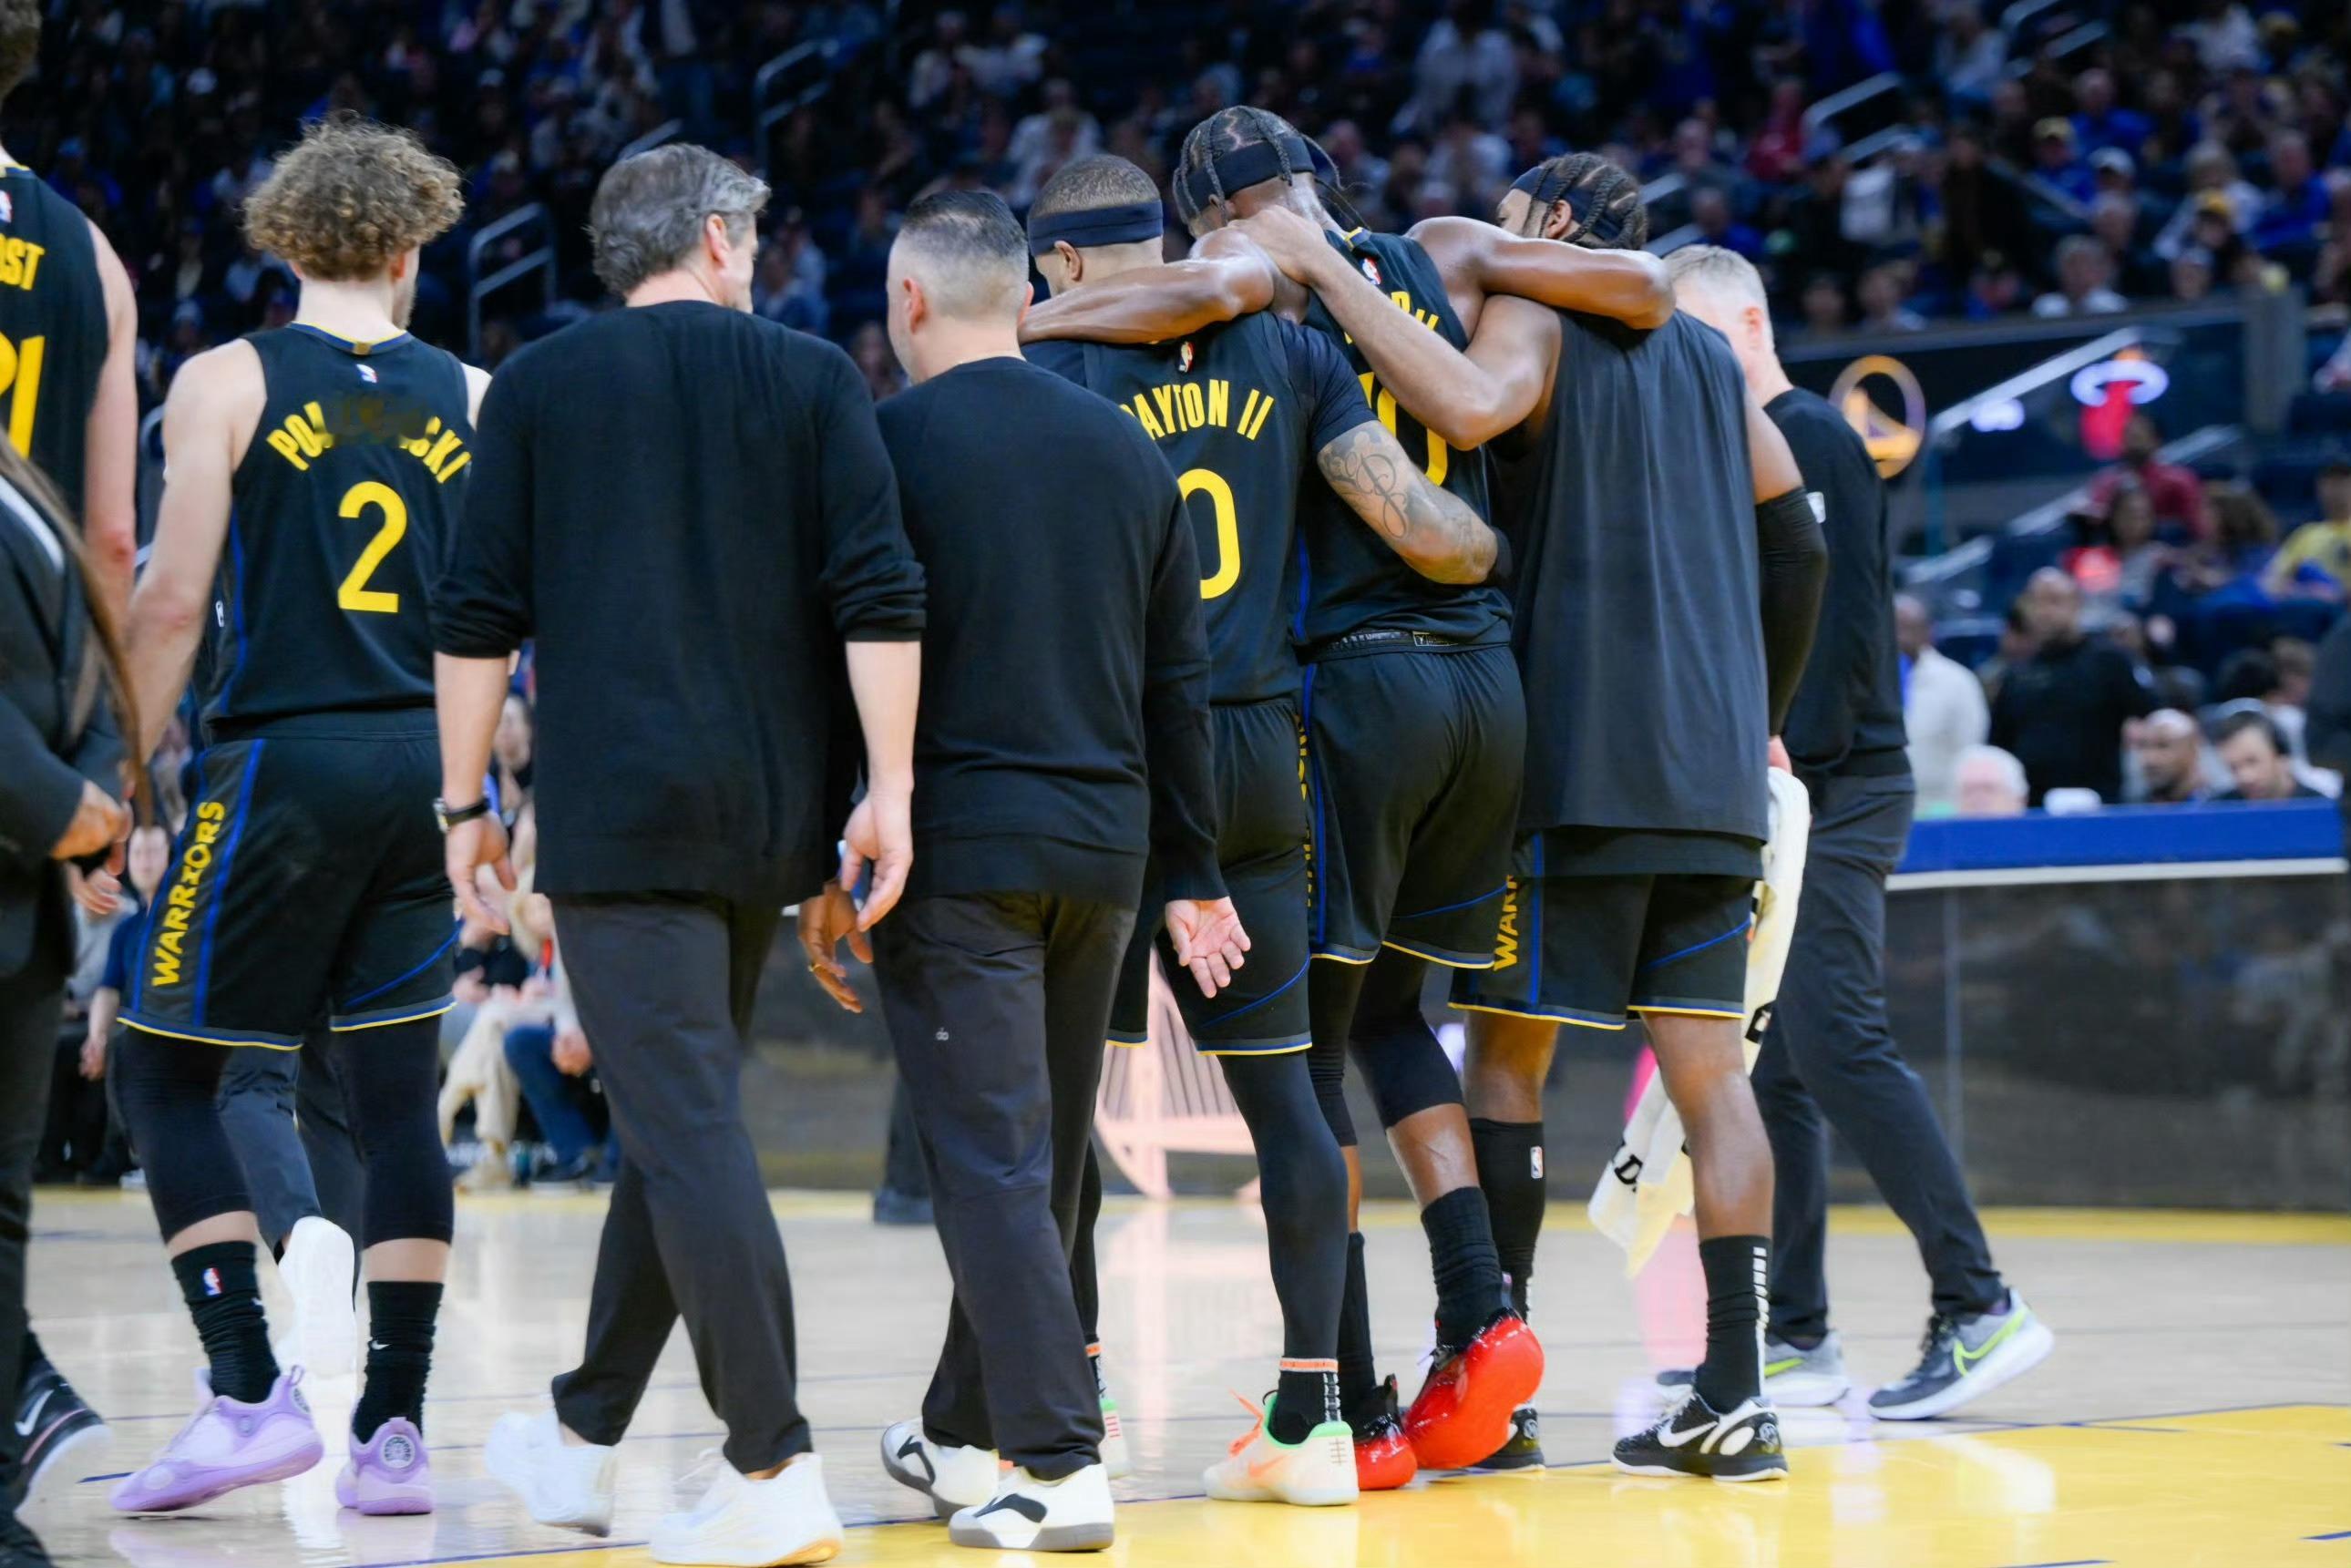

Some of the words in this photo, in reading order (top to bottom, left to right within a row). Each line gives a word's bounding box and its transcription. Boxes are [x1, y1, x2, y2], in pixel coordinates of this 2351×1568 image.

[0, 330, 46, 462] 1
[1119, 378, 1229, 441] AYTON
[1237, 388, 1275, 441] II
[337, 480, 408, 613] 2
[151, 801, 226, 987] WARRIORS
